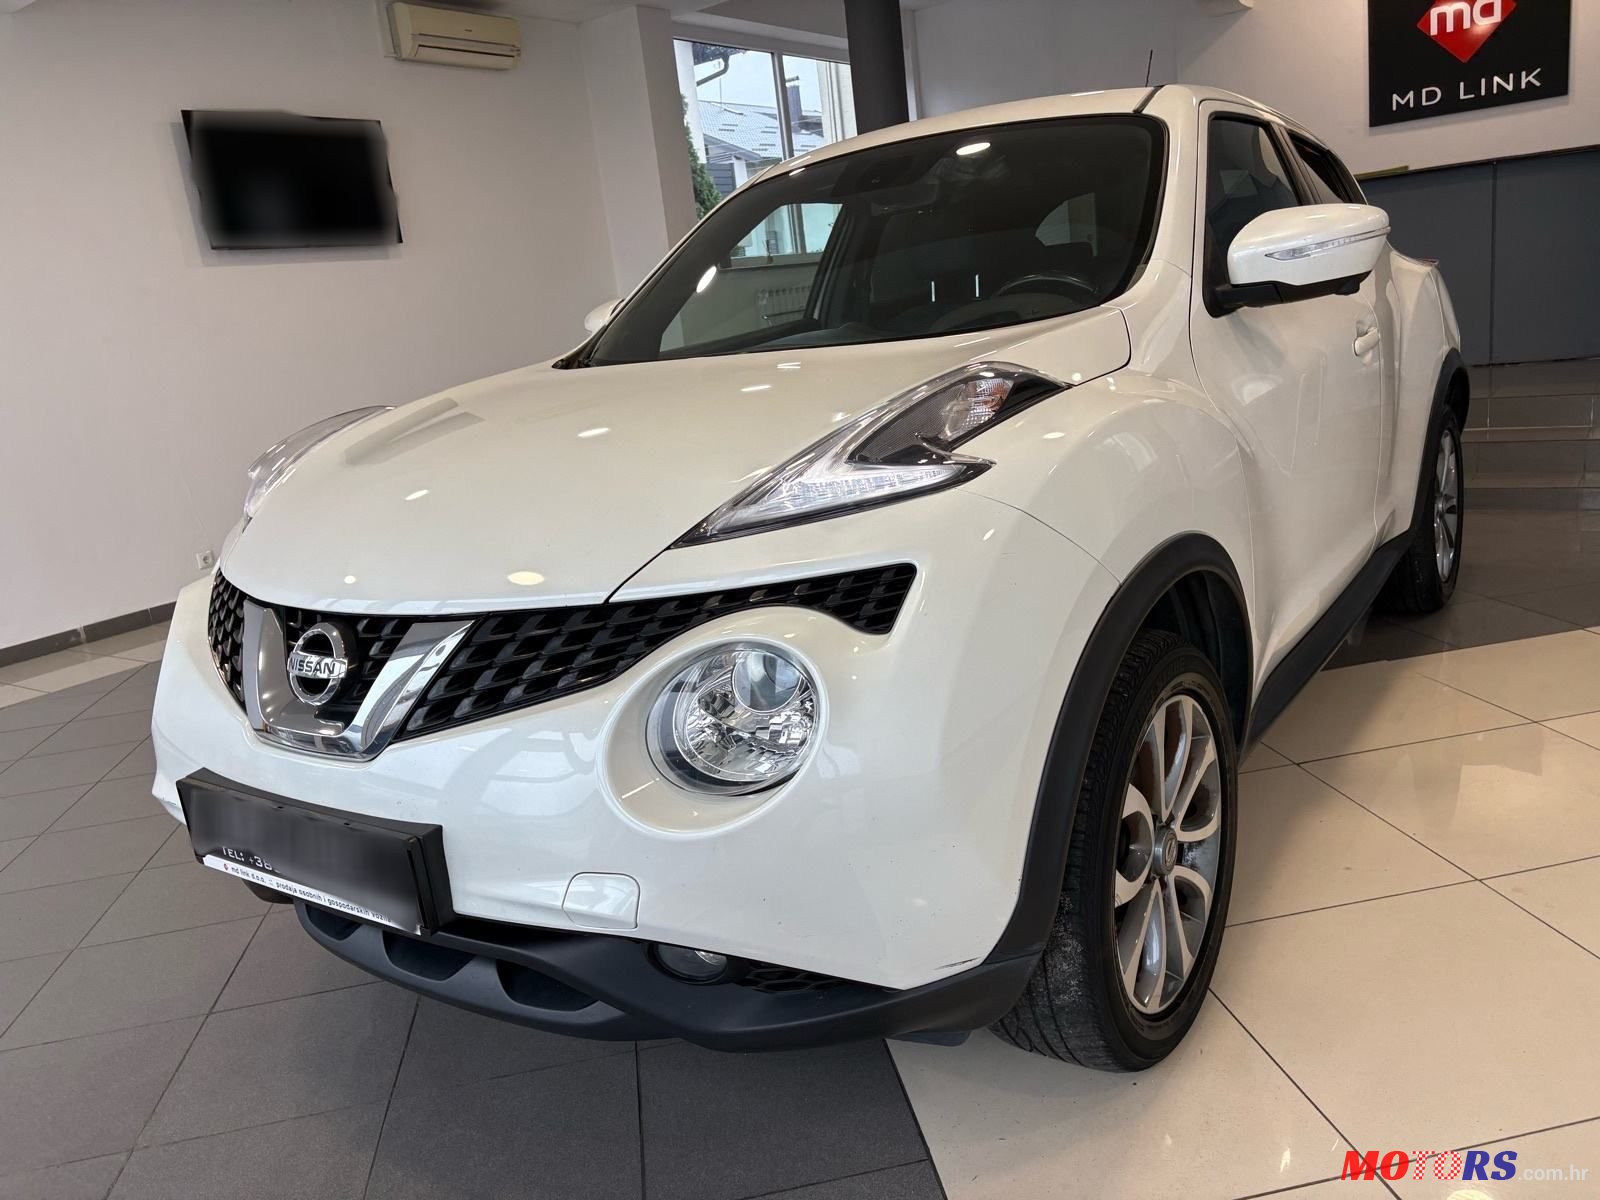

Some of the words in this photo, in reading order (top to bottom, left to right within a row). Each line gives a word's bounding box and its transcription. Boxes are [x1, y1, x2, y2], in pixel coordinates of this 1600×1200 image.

[1392, 86, 1442, 111] MD
[1459, 68, 1542, 100] LINK
[288, 658, 336, 675] NISSAN
